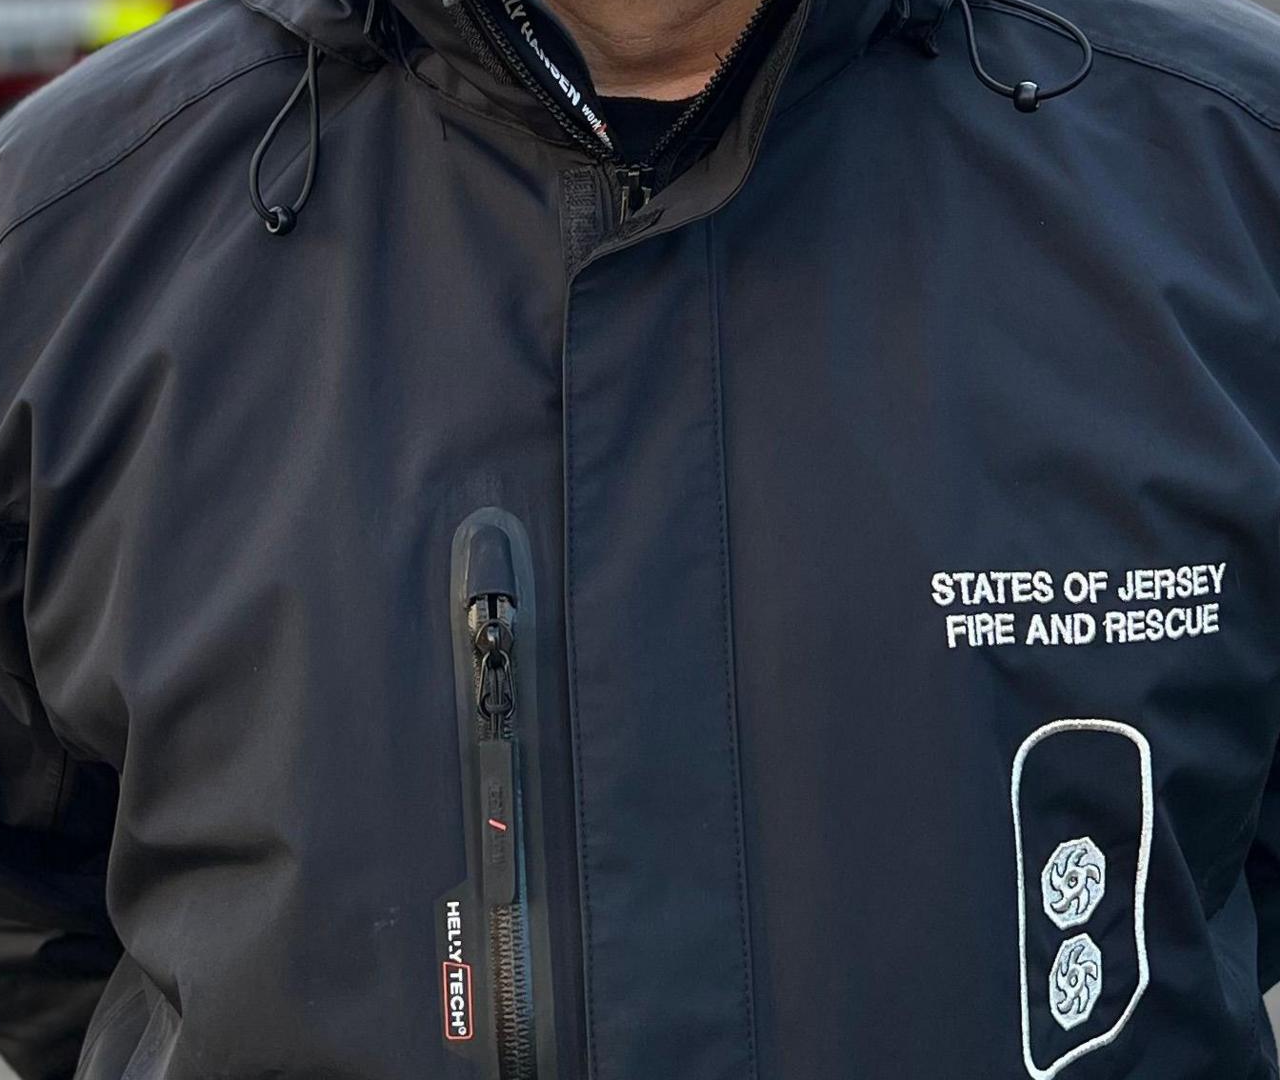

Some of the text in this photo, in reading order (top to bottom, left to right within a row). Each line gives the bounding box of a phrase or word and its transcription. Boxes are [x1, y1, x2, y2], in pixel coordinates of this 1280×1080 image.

[521, 21, 580, 106] HANSEN
[931, 562, 1226, 606] STATES OF JERSEY
[946, 603, 1220, 648] FIRE AND RESCUE
